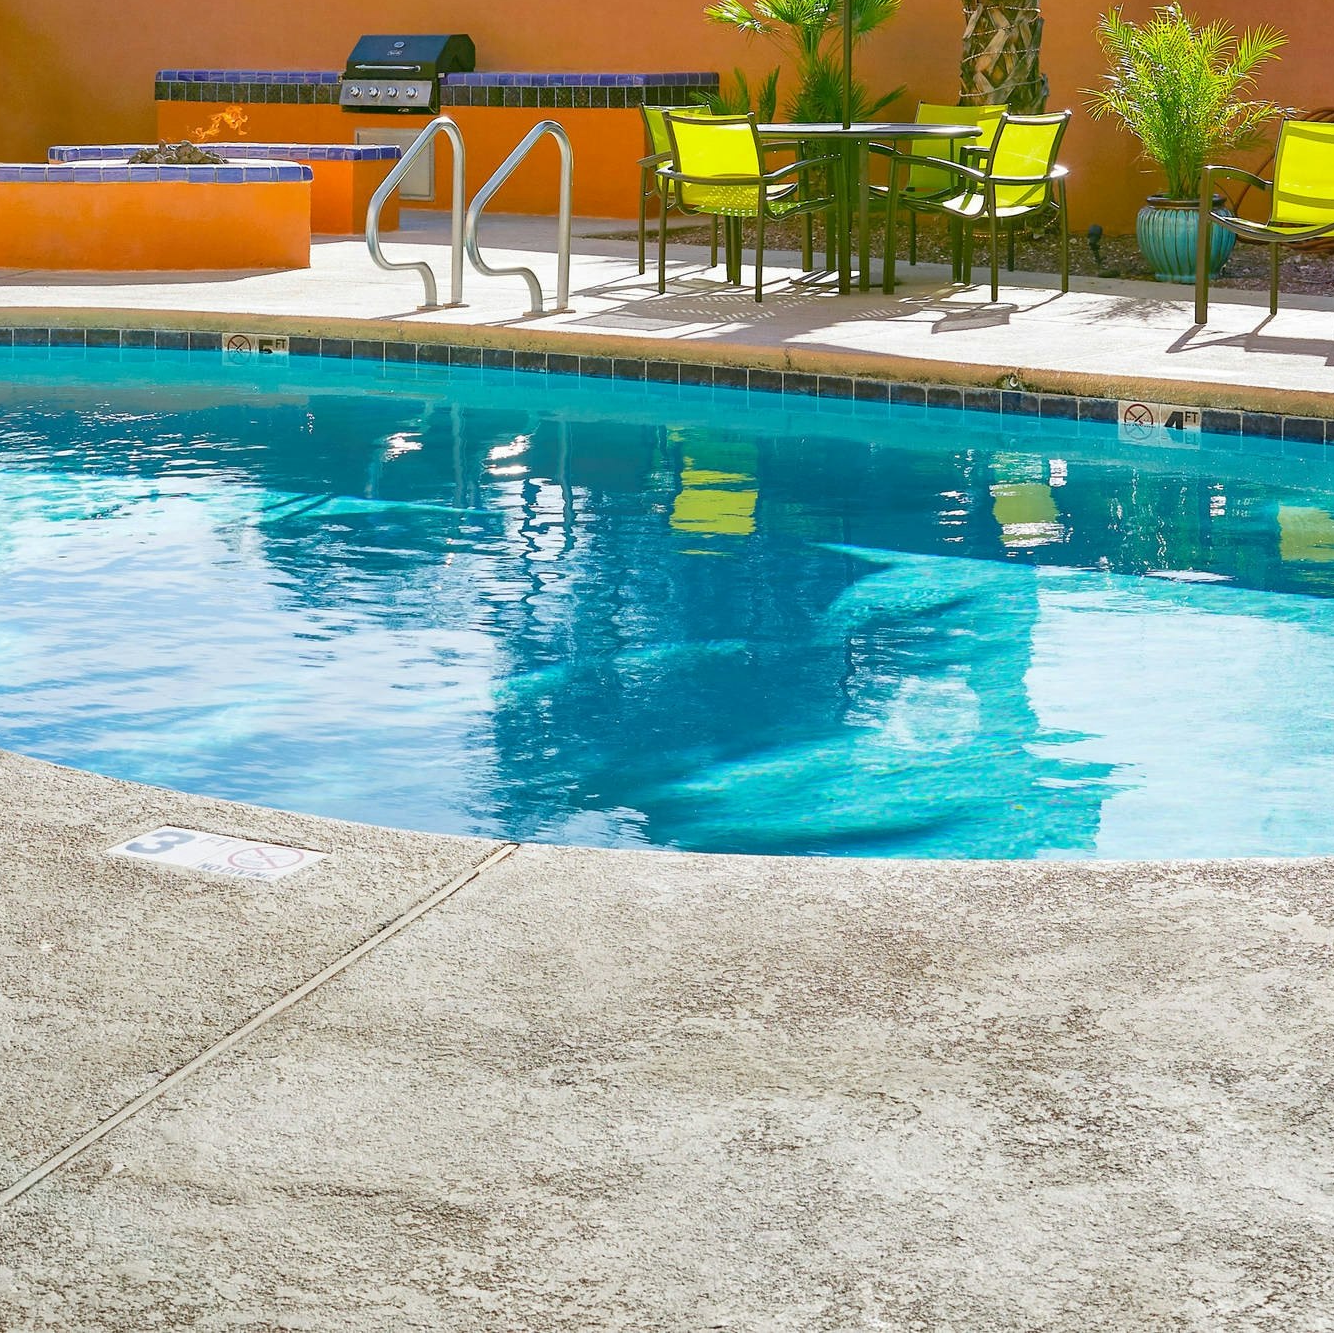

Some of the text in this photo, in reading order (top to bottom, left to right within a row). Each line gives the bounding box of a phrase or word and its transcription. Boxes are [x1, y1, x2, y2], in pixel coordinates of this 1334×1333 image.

[258, 339, 287, 354] 5 FT
[1164, 411, 1199, 430] 4 FT
[125, 831, 237, 855] 3 FT
[196, 862, 222, 871] NO
